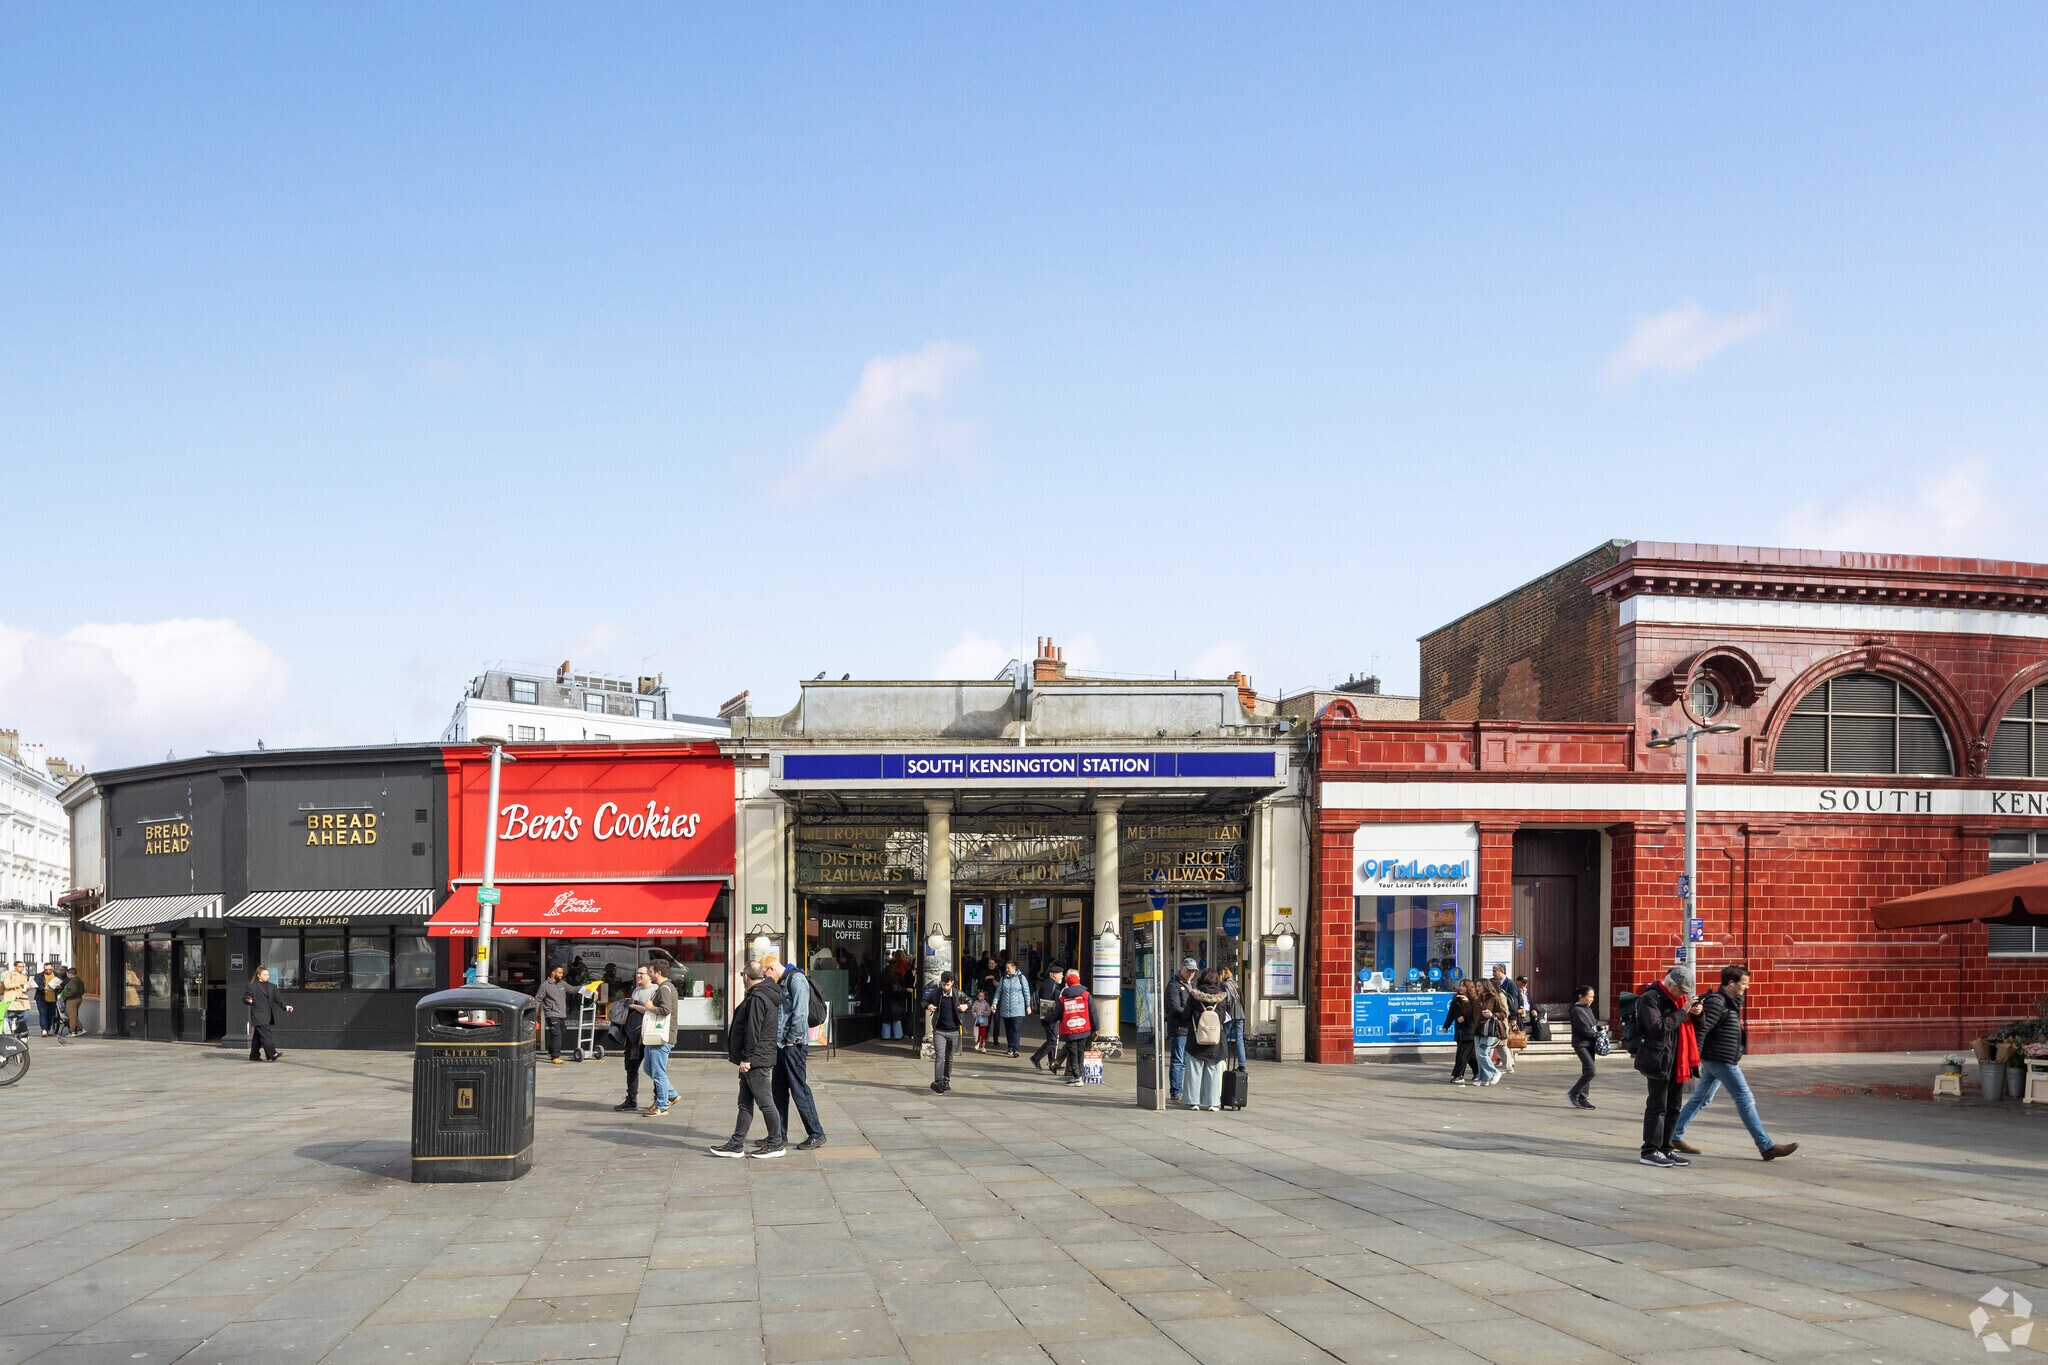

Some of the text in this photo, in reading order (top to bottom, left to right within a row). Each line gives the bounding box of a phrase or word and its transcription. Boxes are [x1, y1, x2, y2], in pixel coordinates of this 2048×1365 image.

[907, 758, 1150, 773] SOUTH KENSINGTON STATION
[1819, 789, 2048, 815] SOUTH KEN
[307, 813, 377, 829] BREAD
[499, 800, 701, 841] Ben's Cookies
[145, 823, 189, 840] BREAD
[996, 821, 1049, 837] SOUTH
[1127, 826, 1242, 839] METROPOLITAN
[306, 829, 377, 846] AHEAD
[145, 838, 190, 855] AHEAD
[820, 852, 903, 866] DISTRICT
[1143, 851, 1226, 865] DISTRICT
[820, 867, 903, 881] RAILWAYS
[1143, 867, 1226, 881] RAILWAYS
[1381, 858, 1471, 878] FixLocal
[561, 904, 602, 913] Cookies
[564, 897, 596, 906] Ben's
[280, 917, 349, 926] BREAD AHEAD
[822, 919, 873, 929] BLANK STREET
[449, 927, 474, 935] Cookies
[500, 927, 519, 935] Coffee
[835, 930, 861, 940] COFFEE
[444, 1049, 487, 1057] LITTER
